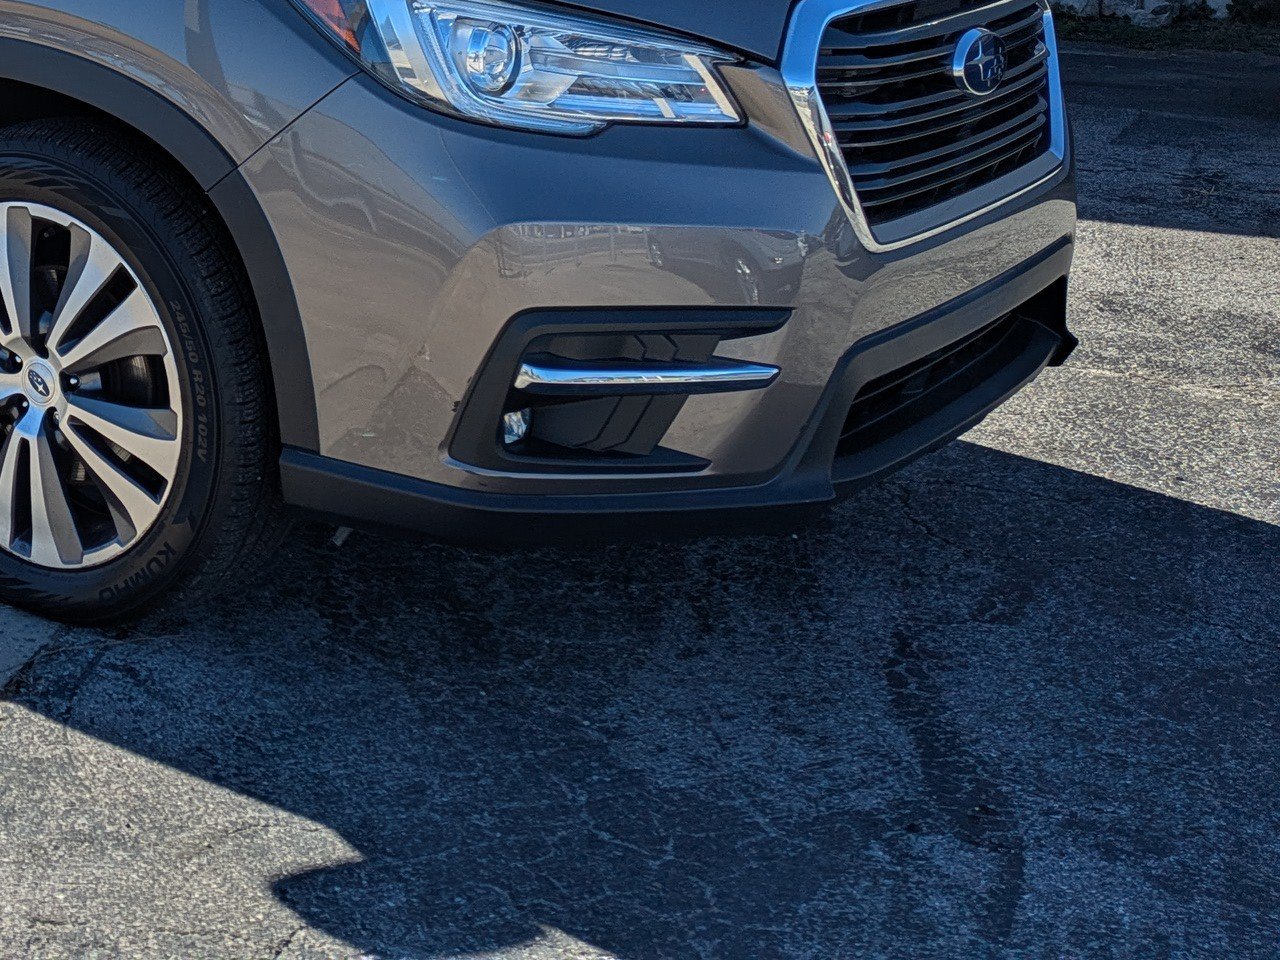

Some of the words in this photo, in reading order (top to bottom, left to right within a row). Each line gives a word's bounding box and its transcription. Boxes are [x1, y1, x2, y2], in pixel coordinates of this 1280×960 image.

[170, 301, 199, 363] 245/50
[193, 370, 206, 407] R20
[98, 541, 177, 605] KUMHO
